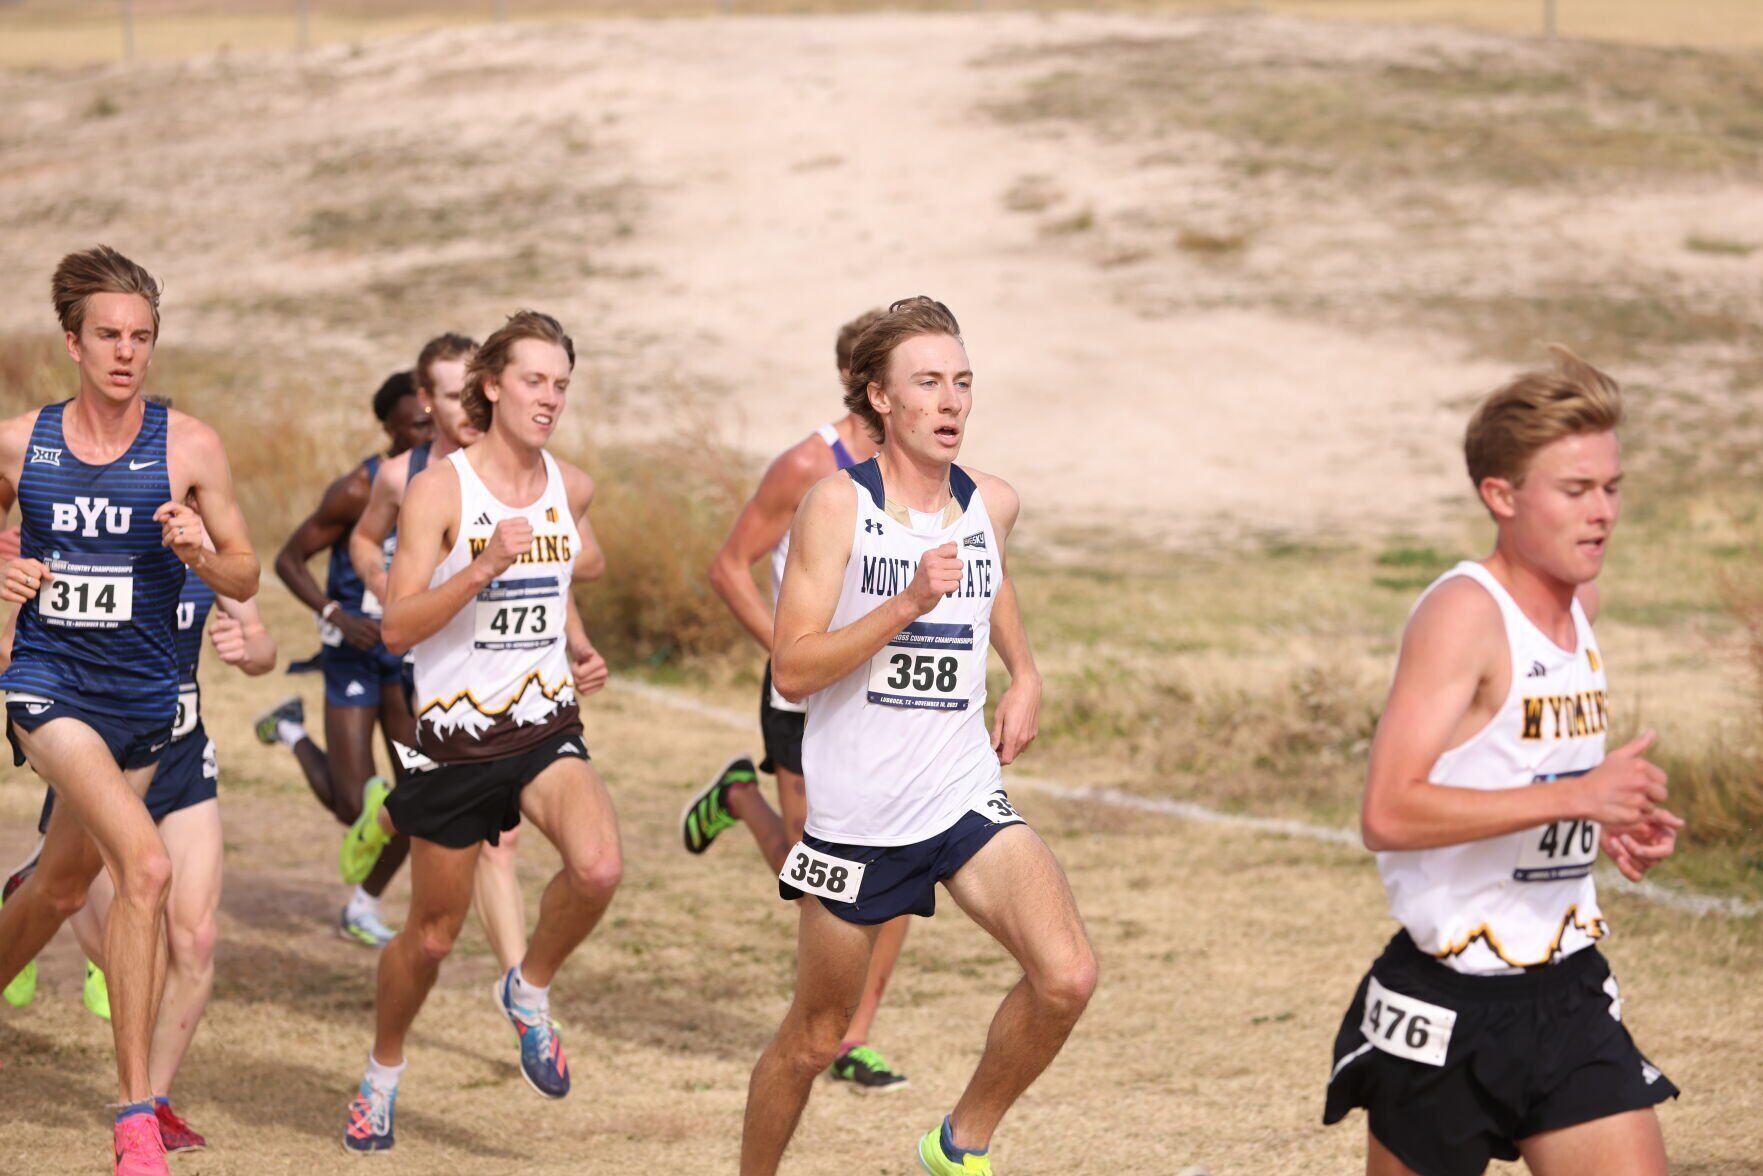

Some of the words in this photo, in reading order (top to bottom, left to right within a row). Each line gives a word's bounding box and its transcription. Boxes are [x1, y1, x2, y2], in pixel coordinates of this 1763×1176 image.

[52, 496, 132, 537] BYU
[51, 580, 116, 613] 314
[490, 605, 547, 635] 473
[910, 635, 934, 643] COUNTRY
[887, 653, 958, 692] 358
[880, 696, 904, 705] LUBBOCK,
[1538, 820, 1594, 858] 476
[790, 852, 848, 893] 358
[1370, 999, 1431, 1048] 476
